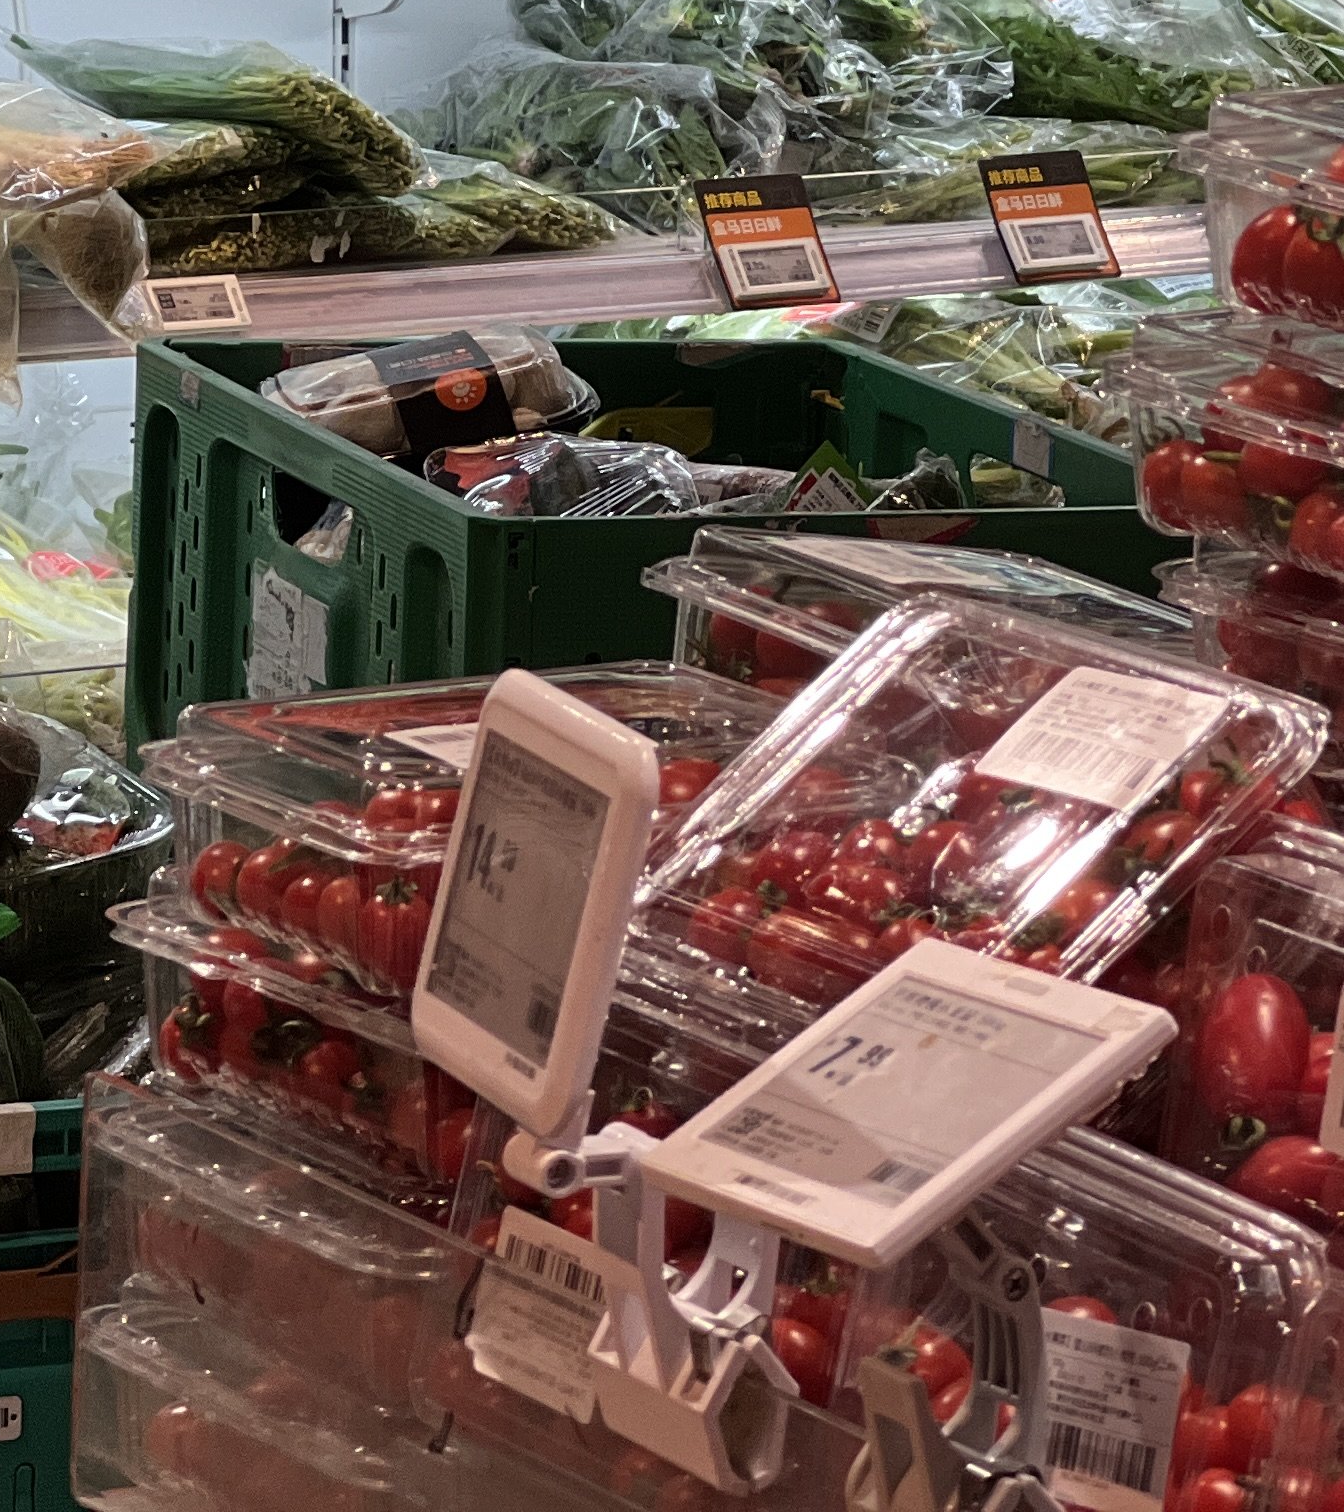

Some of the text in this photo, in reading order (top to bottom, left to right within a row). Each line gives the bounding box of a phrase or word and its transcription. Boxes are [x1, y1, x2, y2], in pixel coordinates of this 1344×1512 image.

[988, 167, 1044, 187] 推荐商品
[703, 189, 762, 209] 推荐商品
[995, 192, 1064, 214] 盒马日日鲜
[711, 216, 782, 237] 盒马日日鲜
